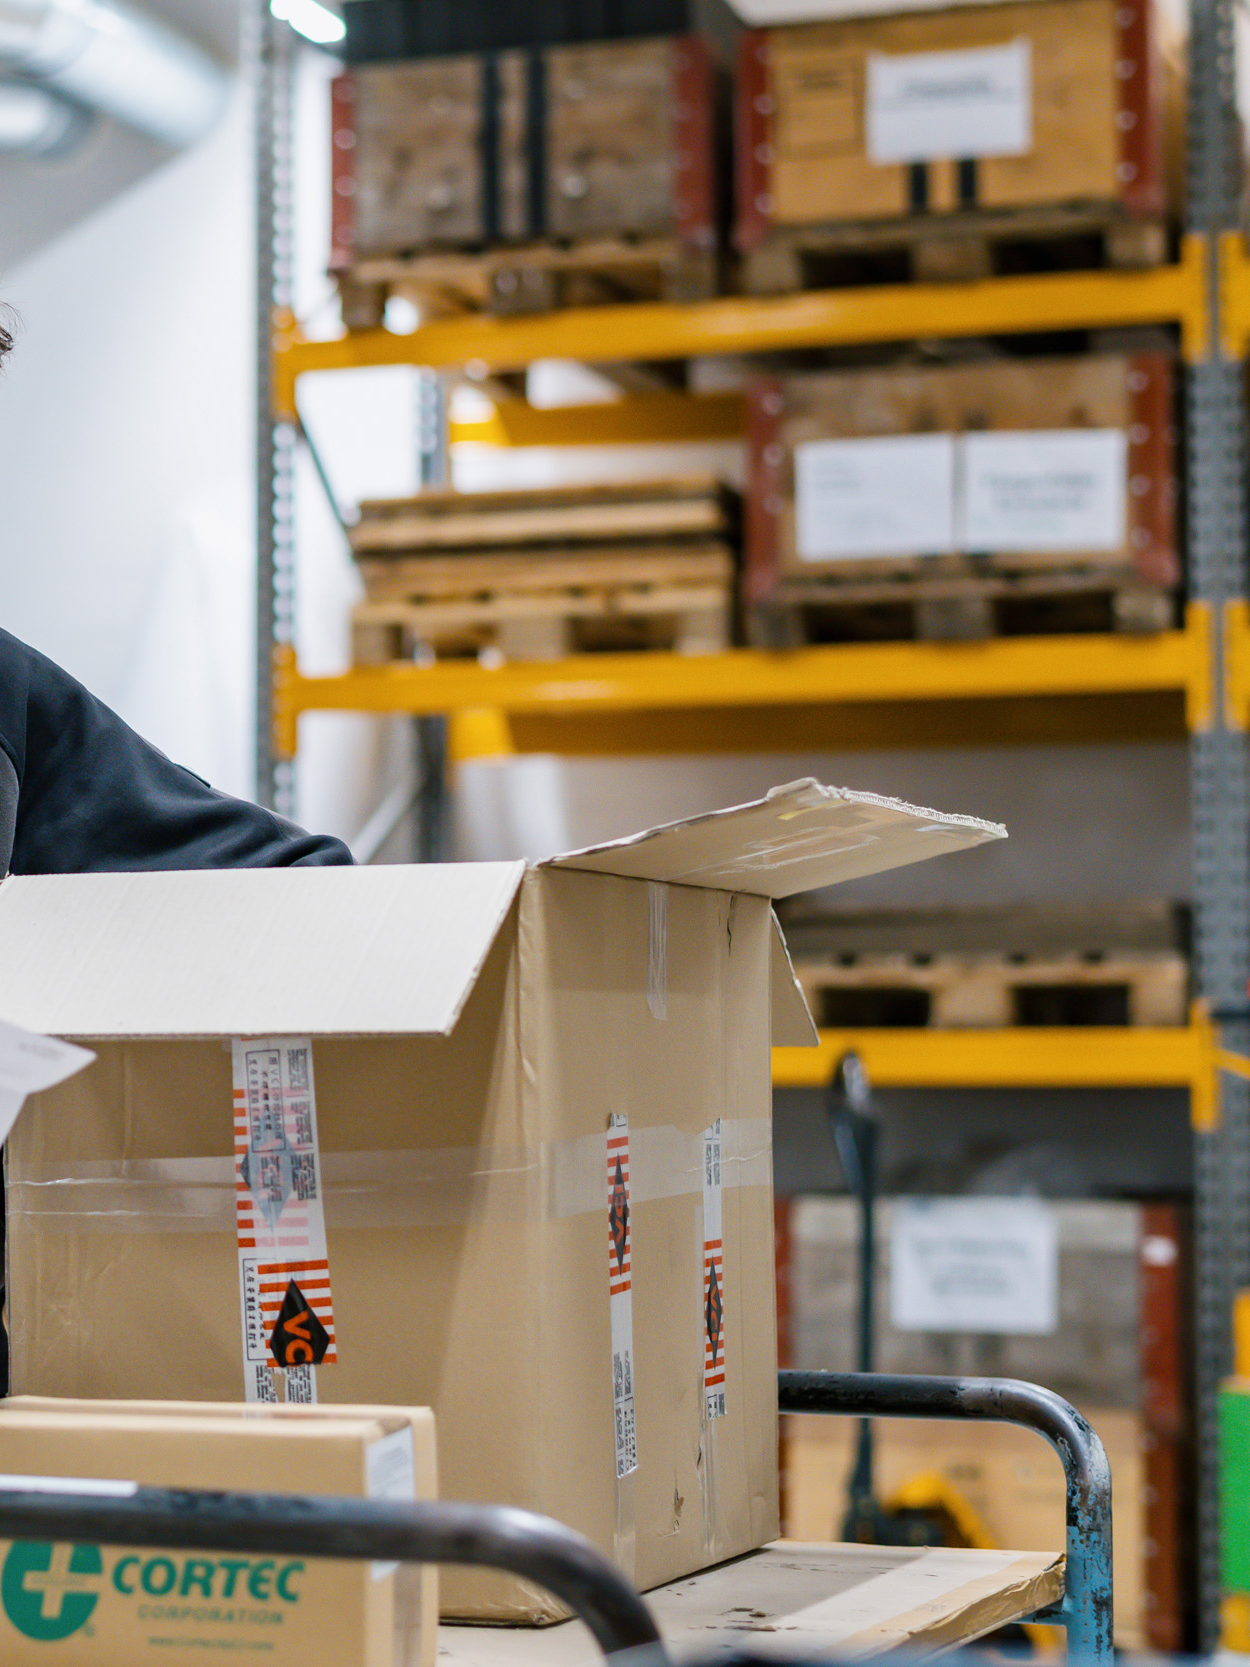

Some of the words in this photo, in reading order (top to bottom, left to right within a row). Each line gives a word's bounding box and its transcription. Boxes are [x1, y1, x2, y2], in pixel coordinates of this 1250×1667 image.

[614, 1184, 625, 1244] VCI
[710, 1284, 718, 1342] VCI
[111, 1554, 305, 1603] CORTEC
[136, 1603, 284, 1625] CORPORATION
